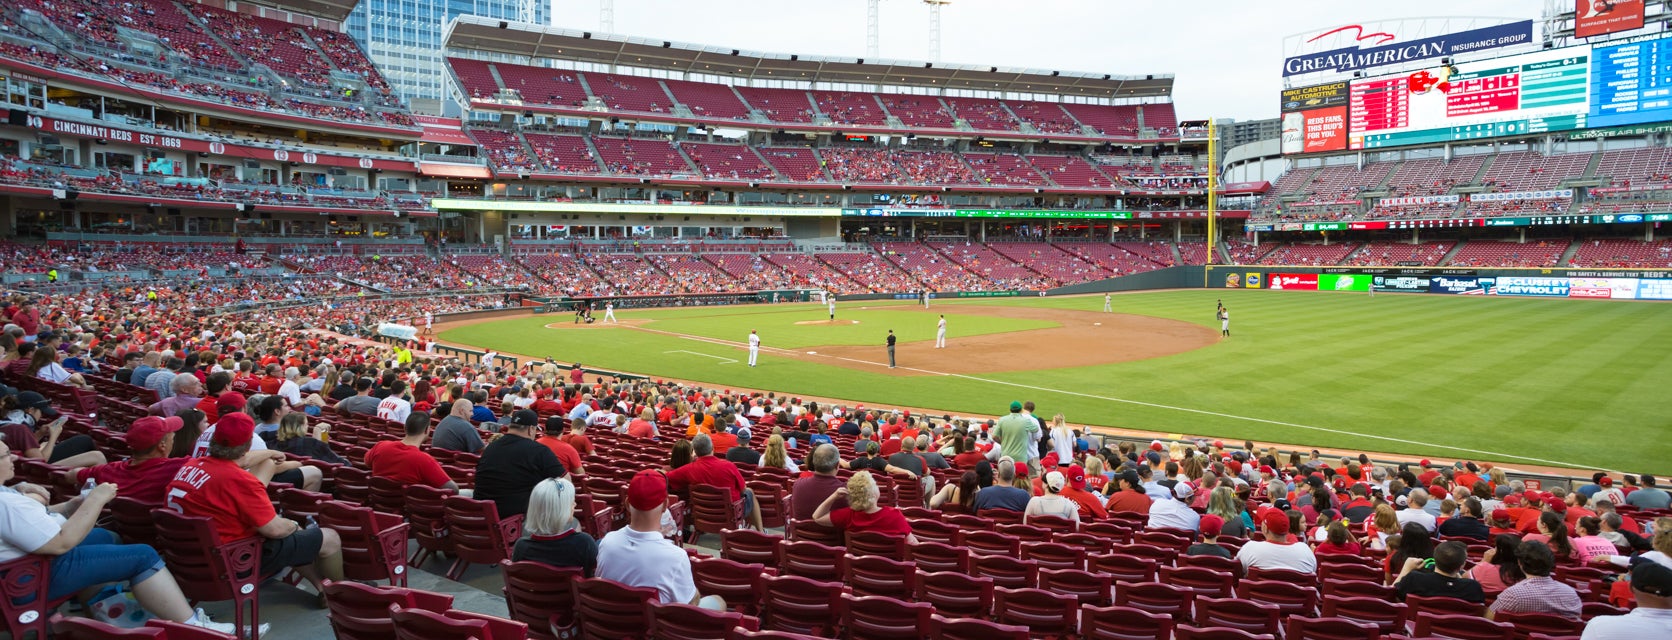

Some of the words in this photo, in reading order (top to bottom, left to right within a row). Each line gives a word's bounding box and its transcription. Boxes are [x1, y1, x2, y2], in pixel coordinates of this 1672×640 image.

[1451, 39, 1496, 52] INSURANCE
[1498, 33, 1527, 45] GROUP
[1303, 83, 1345, 94] CASTRUCCI
[1290, 90, 1337, 101] AUTOMOTIVE
[1308, 124, 1322, 132] THIS
[54, 120, 107, 138] CINCINNATI
[110, 130, 132, 142] REDS
[140, 134, 159, 145] EST.
[162, 138, 181, 148] 1869
[1570, 130, 1616, 140] ULTIMATE
[277, 151, 286, 161] 13
[1497, 286, 1568, 294] CHEVROLET
[173, 464, 211, 490] BENCH
[167, 487, 188, 514] 5
